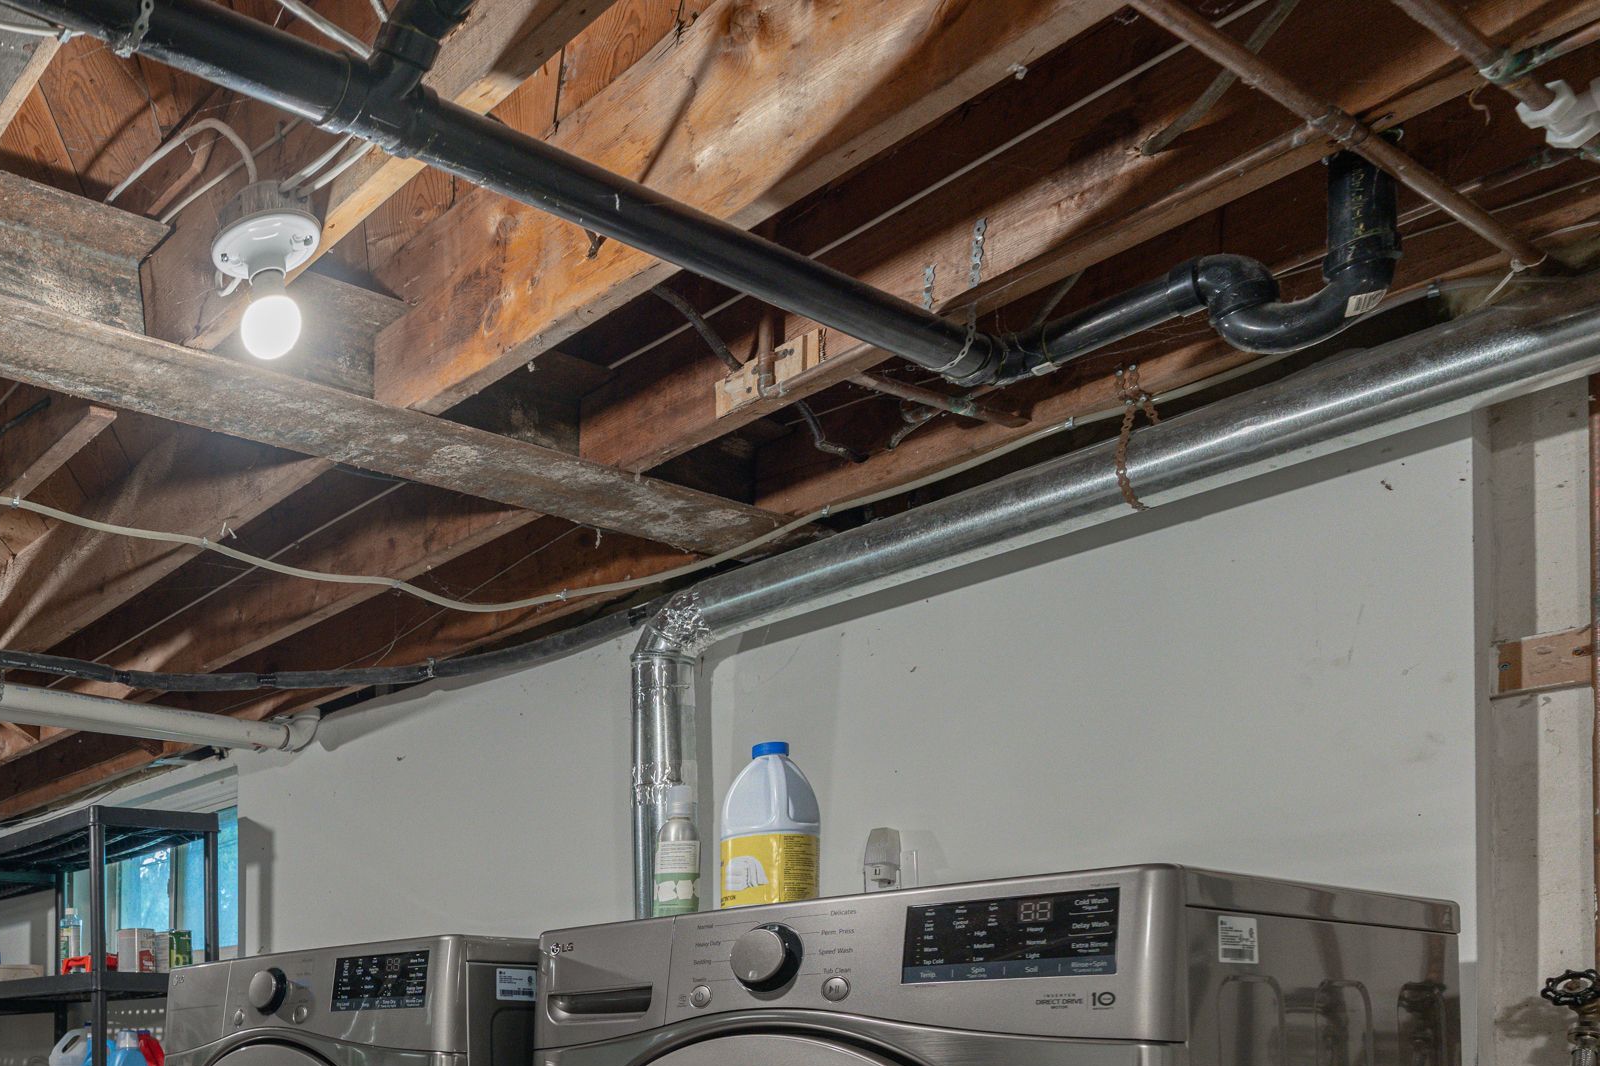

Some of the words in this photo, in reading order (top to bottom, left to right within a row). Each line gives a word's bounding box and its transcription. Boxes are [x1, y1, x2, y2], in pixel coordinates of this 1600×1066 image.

[830, 908, 857, 916] Delicates
[561, 942, 574, 953] LG
[1091, 991, 1116, 1007] 10
